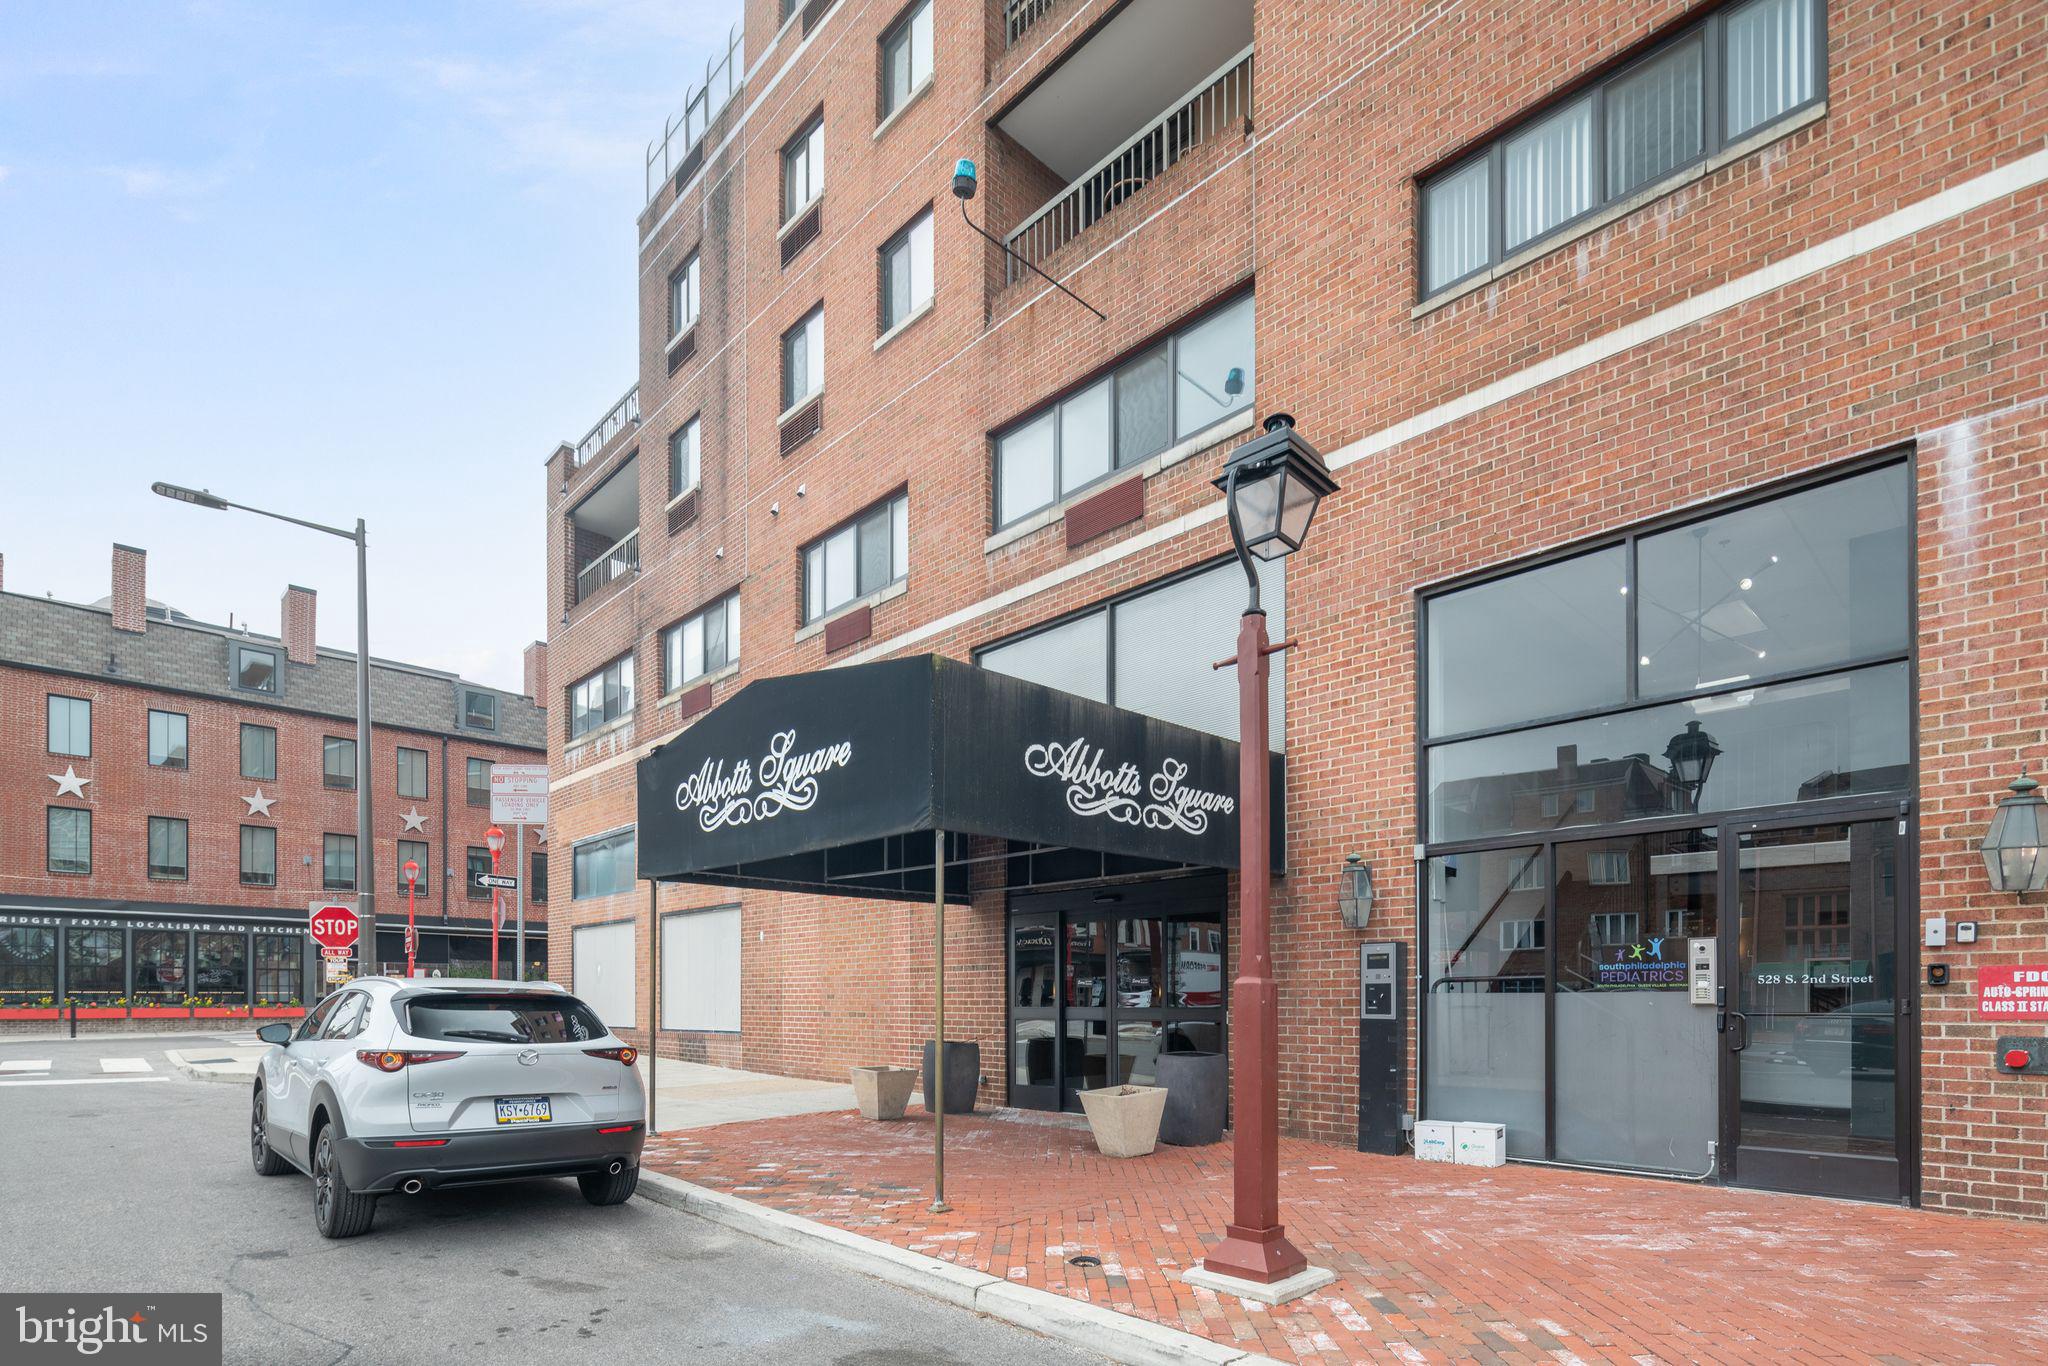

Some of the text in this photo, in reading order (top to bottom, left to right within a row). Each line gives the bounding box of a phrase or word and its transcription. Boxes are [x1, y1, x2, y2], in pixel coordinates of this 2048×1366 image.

[676, 729, 852, 811] Abbotts Square
[1025, 737, 1234, 816] Abbotts Square
[71, 918, 118, 927] FOY'S
[126, 920, 174, 929] LOCAL
[253, 926, 309, 934] KITCHEN
[314, 918, 358, 936] STOP
[1599, 961, 1686, 971] southphiladelphia
[1601, 970, 1684, 982] PEDIATRICS
[1758, 973, 1874, 984] 528 S. 2nd Street
[1982, 1001, 2015, 1012] CLASS
